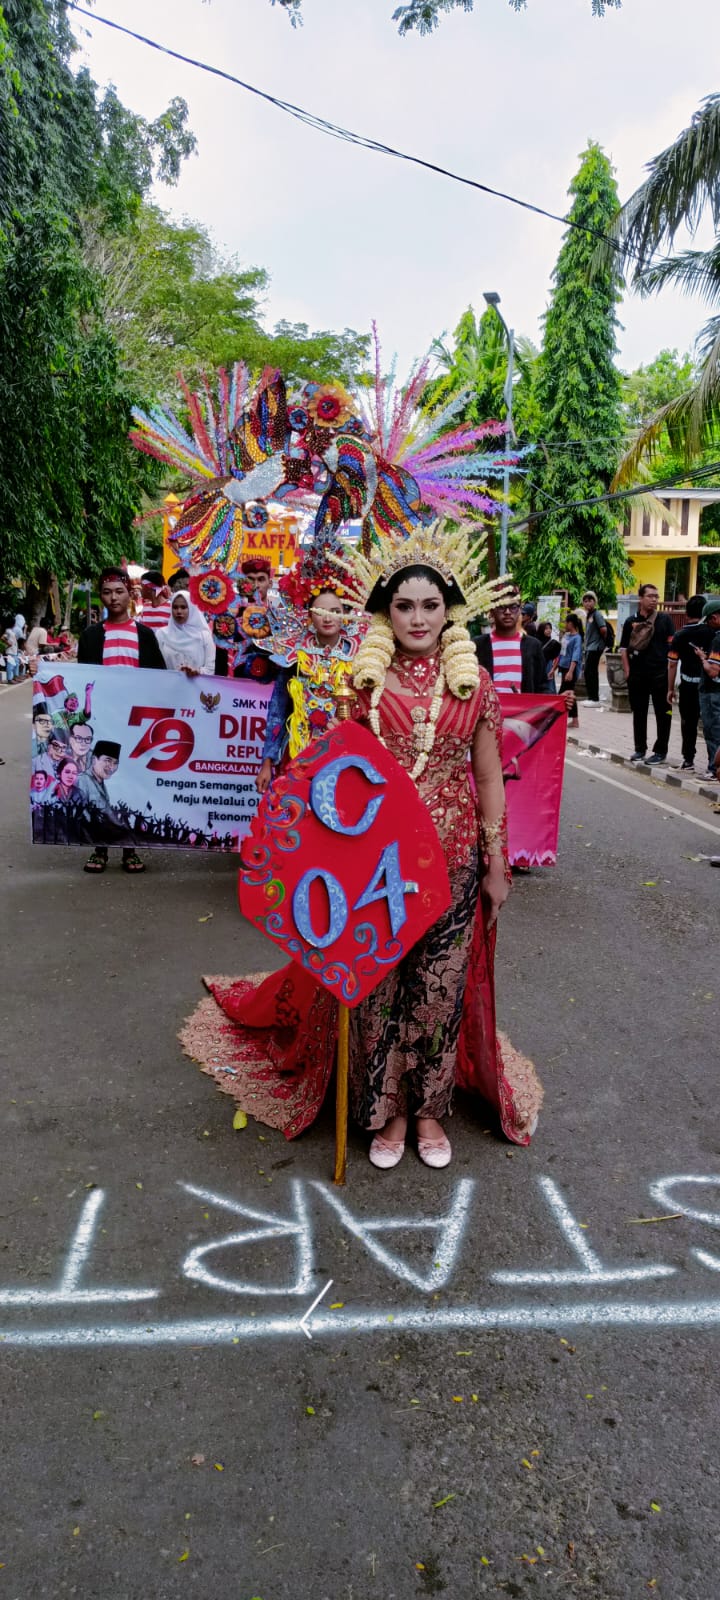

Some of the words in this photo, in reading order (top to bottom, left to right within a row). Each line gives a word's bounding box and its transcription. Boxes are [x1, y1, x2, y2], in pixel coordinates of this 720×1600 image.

[247, 532, 296, 550] KAFFA
[232, 698, 257, 709] SMK
[128, 705, 195, 772] 79
[180, 708, 195, 718] TH
[194, 762, 253, 774] BANGKALAN
[156, 777, 198, 790] Dengan
[199, 780, 254, 793] Semangat
[173, 794, 200, 806] Maju
[202, 795, 245, 807] Melalui
[309, 754, 387, 837] C
[291, 840, 419, 950] 04
